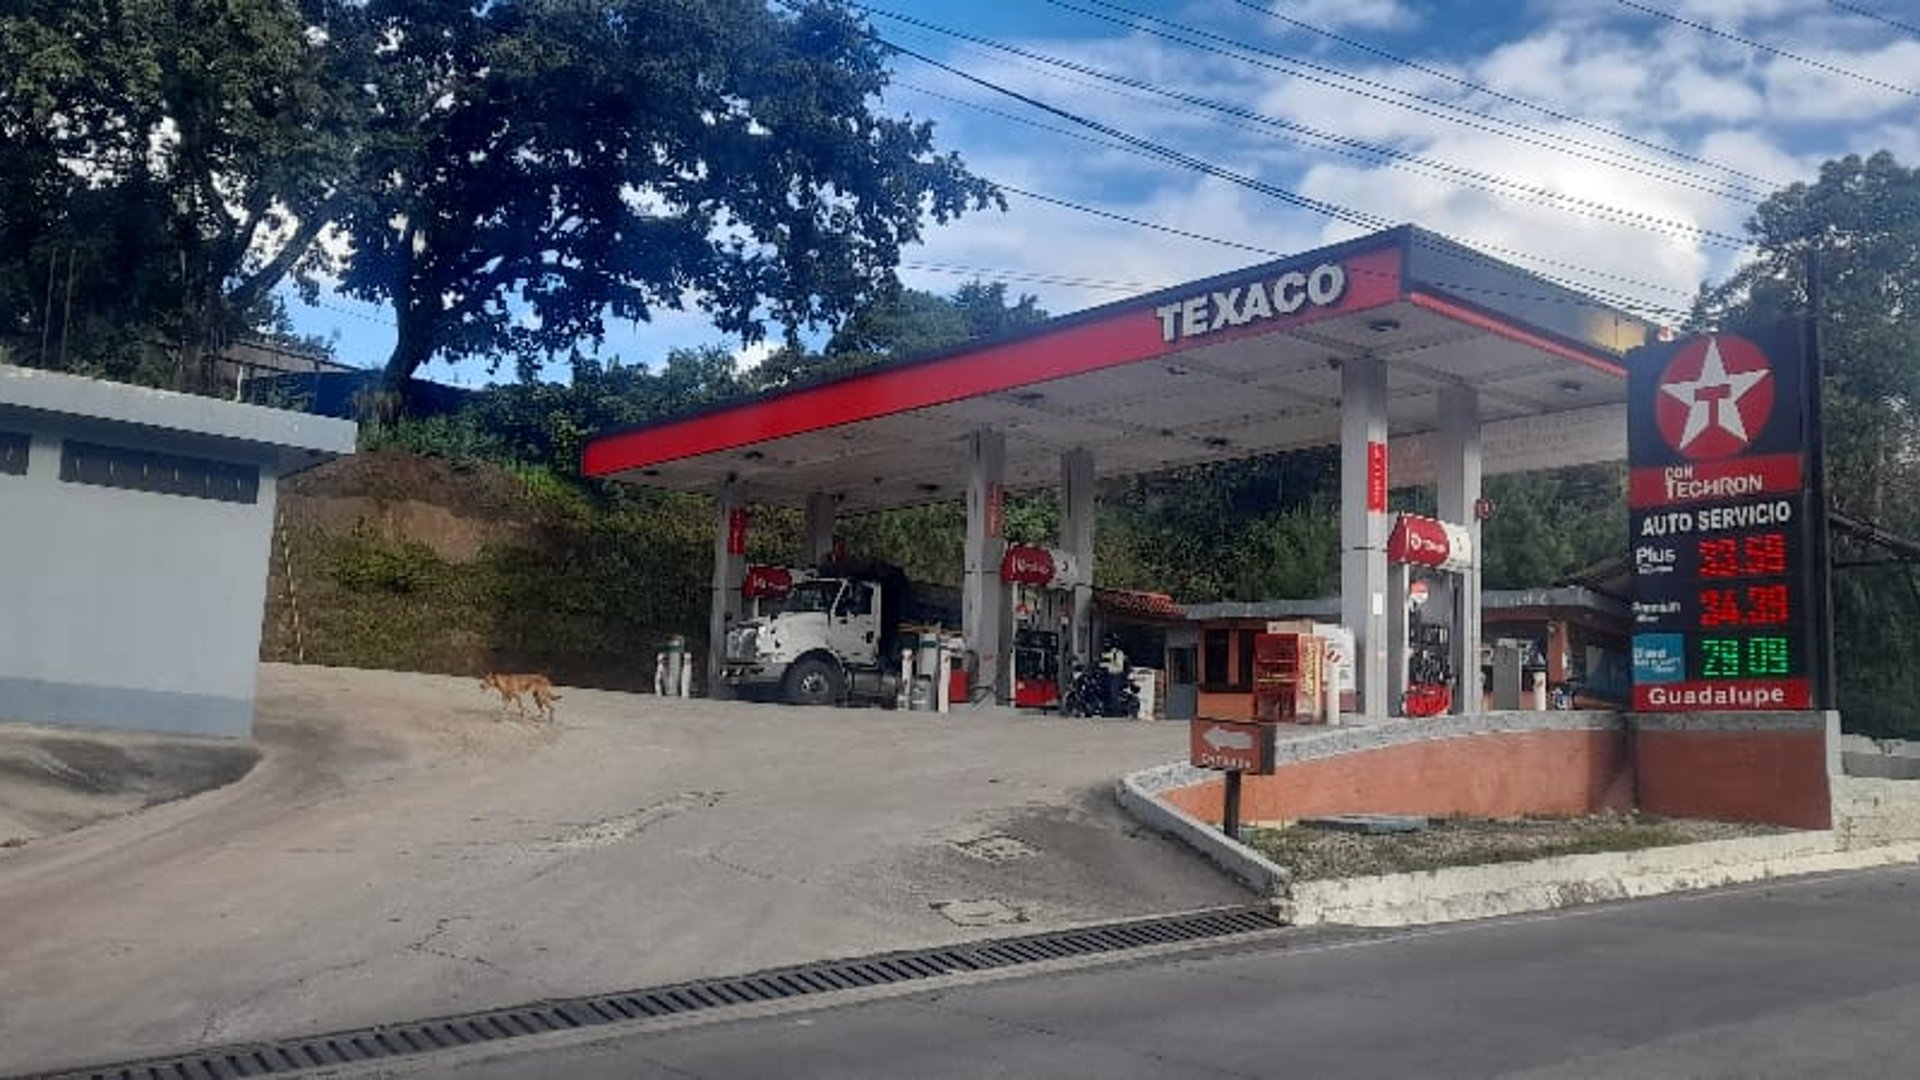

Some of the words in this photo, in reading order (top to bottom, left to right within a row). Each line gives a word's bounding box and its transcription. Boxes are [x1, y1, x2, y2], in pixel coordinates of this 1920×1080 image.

[1156, 263, 1346, 342] TEXACO
[1664, 466, 1694, 479] CON
[1665, 474, 1763, 500] TECHRON
[1641, 512, 1693, 537] AUTO
[1698, 501, 1792, 531] SERVICIO
[1636, 546, 1677, 565] Plus
[1648, 686, 1785, 708] Guadalupe
